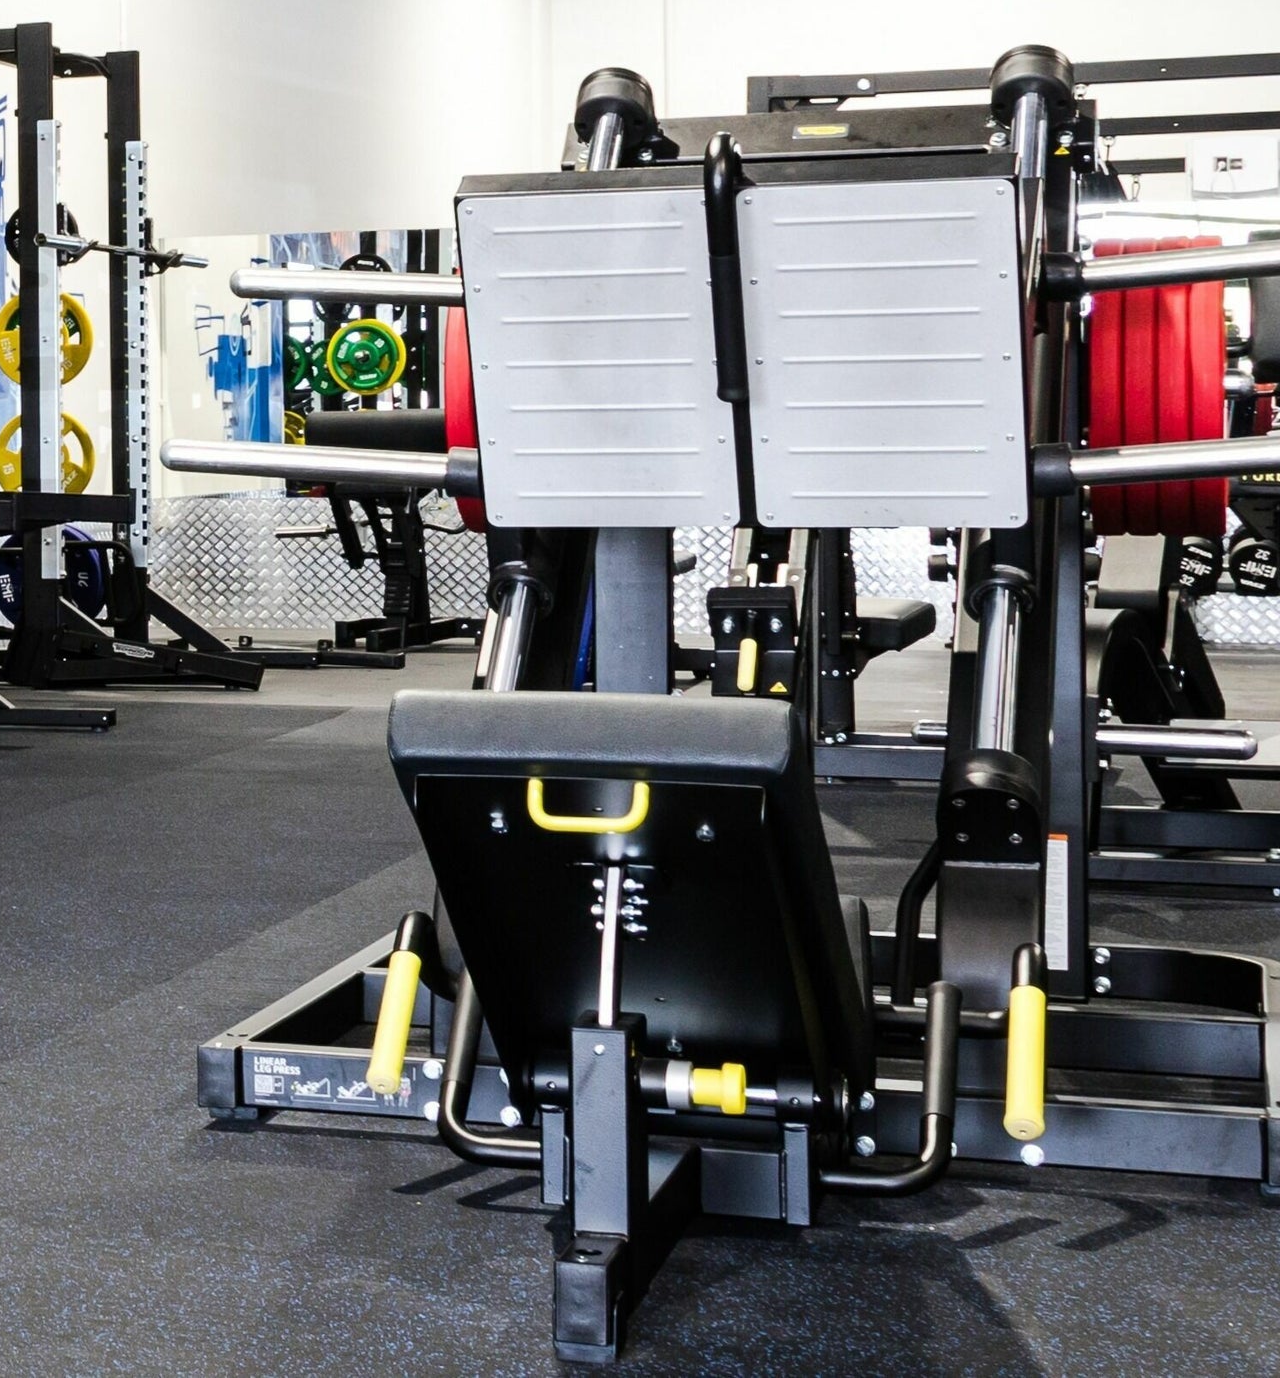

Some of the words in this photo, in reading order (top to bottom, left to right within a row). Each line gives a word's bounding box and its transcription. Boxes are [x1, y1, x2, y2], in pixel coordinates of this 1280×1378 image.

[253, 1056, 288, 1066] LINEAR
[253, 1064, 273, 1074] LEG
[273, 1065, 302, 1076] PRESS
